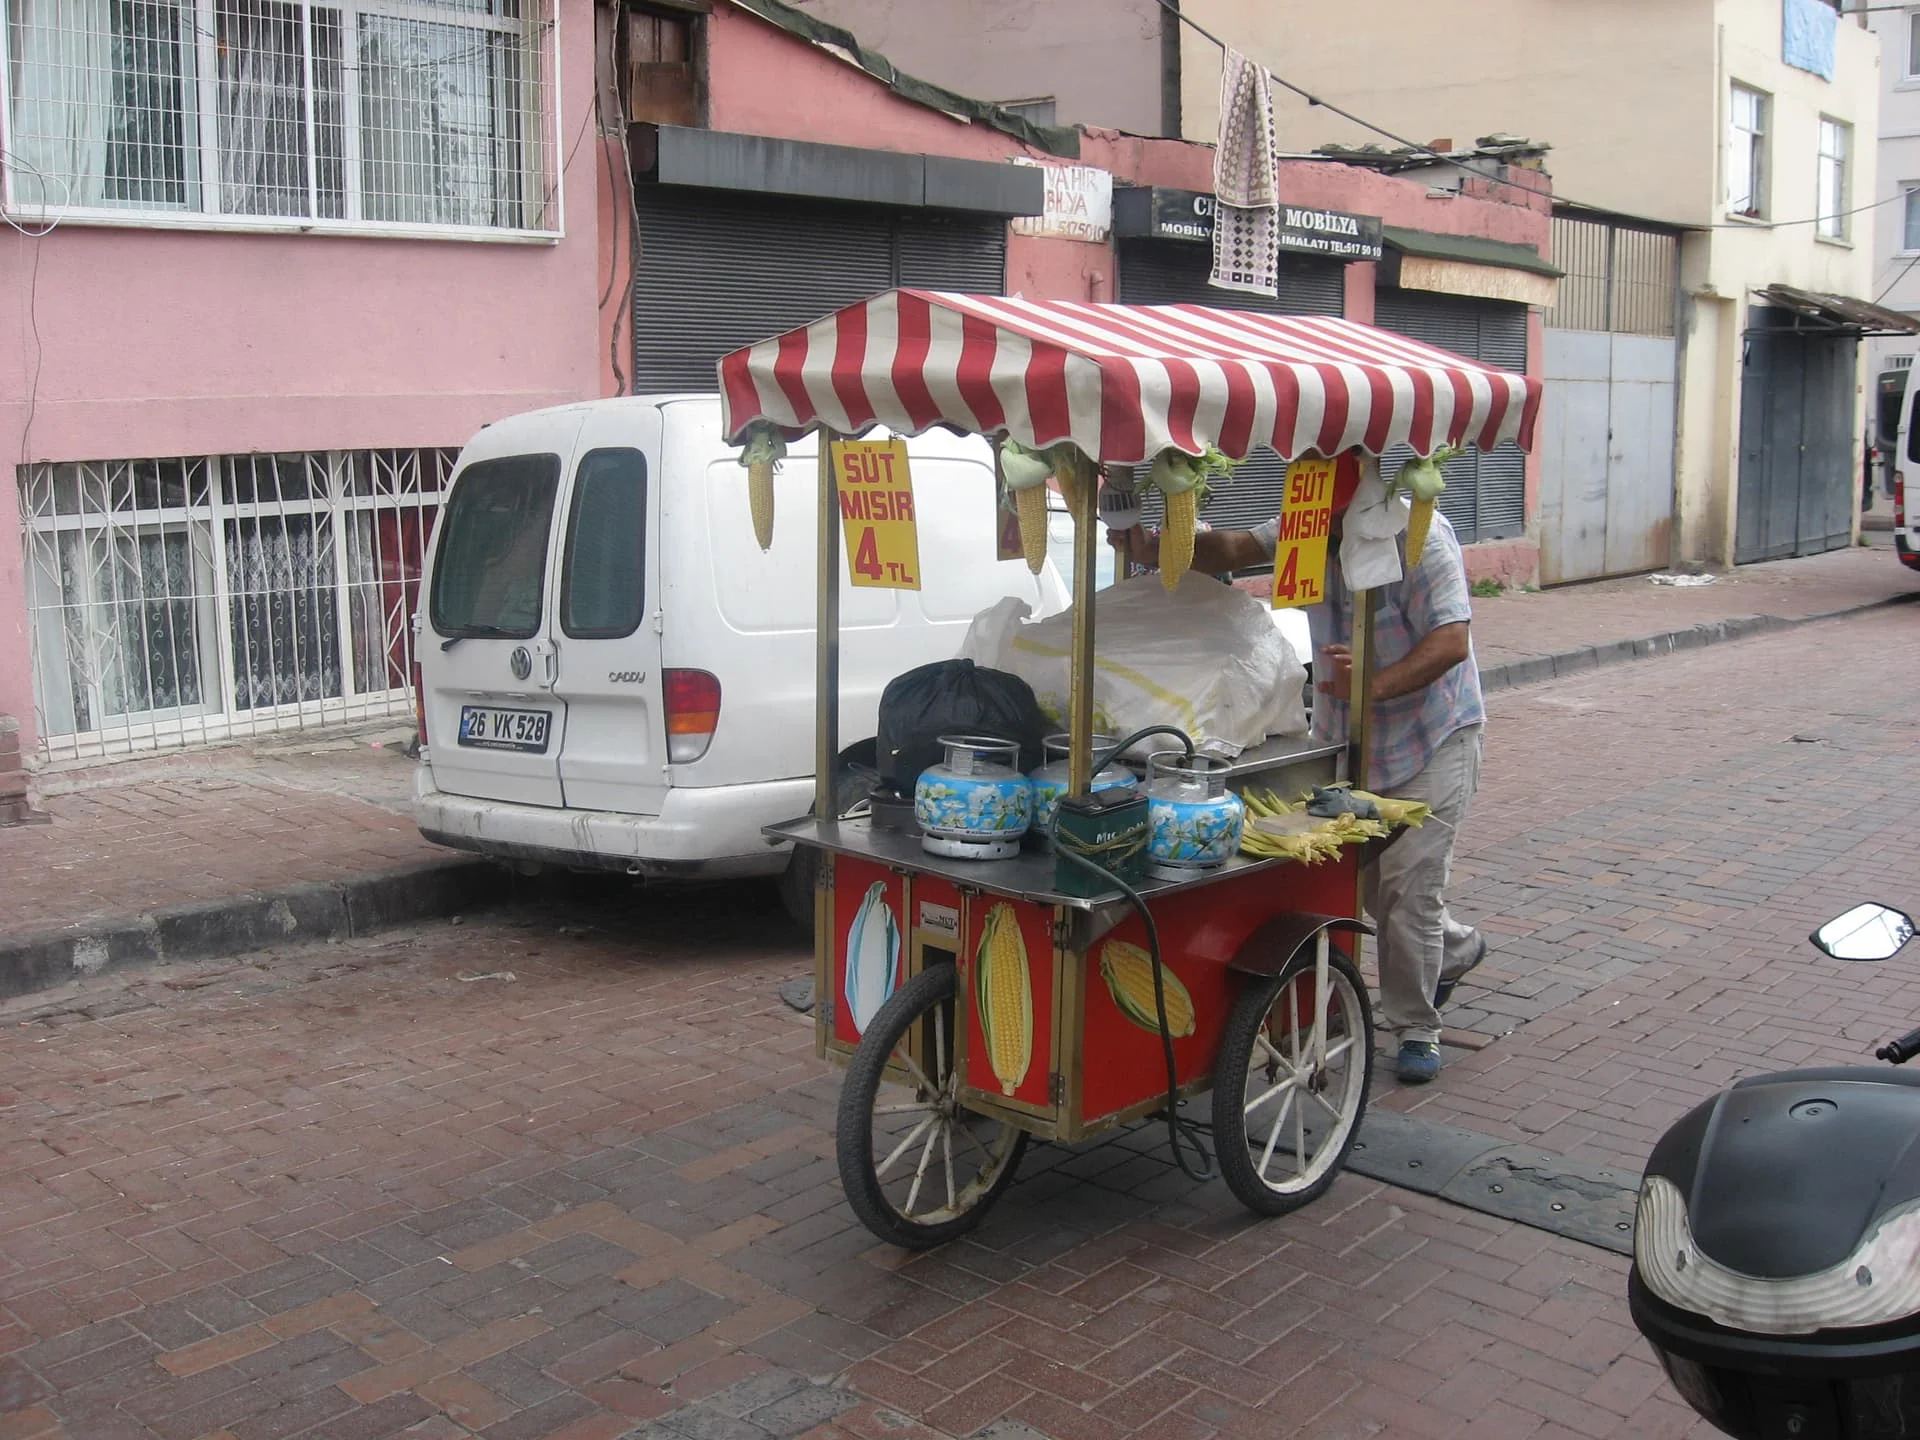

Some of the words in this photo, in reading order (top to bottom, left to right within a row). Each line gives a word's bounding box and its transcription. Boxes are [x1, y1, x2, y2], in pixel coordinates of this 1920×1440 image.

[1161, 221, 1213, 238] MOBİLY
[1286, 209, 1359, 235] MOBİLYA
[843, 446, 895, 484] SÜT
[1290, 466, 1329, 504] SÜT
[839, 490, 914, 522] MISIR
[1279, 507, 1331, 542] MISIR
[855, 526, 883, 581] 4
[886, 562, 913, 583] TL
[1276, 546, 1299, 601] 4
[1300, 578, 1319, 598] TL
[608, 671, 646, 684] CADDY
[467, 711, 486, 737] 26
[494, 713, 514, 739] VK
[515, 715, 545, 742] 528
